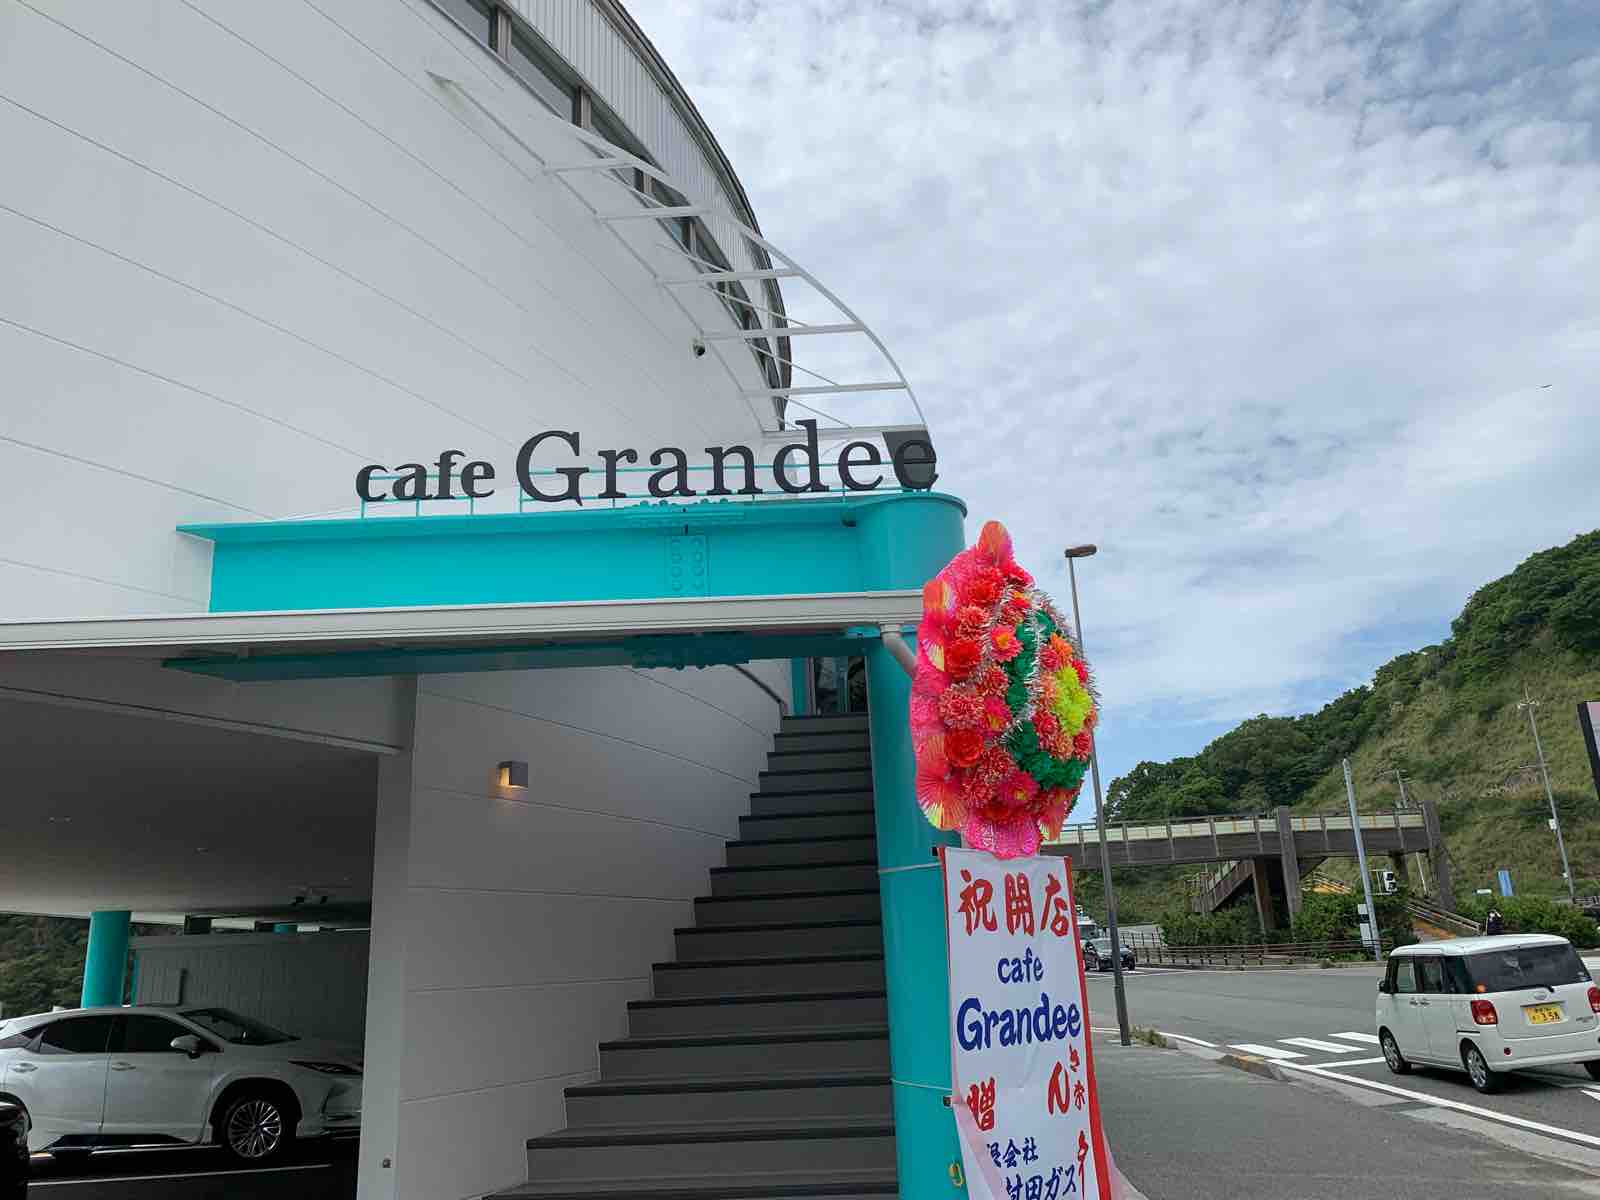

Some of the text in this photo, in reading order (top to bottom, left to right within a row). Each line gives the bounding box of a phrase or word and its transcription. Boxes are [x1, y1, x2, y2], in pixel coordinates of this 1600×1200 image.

[355, 418, 940, 506] cafe Grandee
[958, 869, 1070, 937] 祝開店
[997, 946, 1045, 984] cafe
[956, 992, 1082, 1051] Grandee
